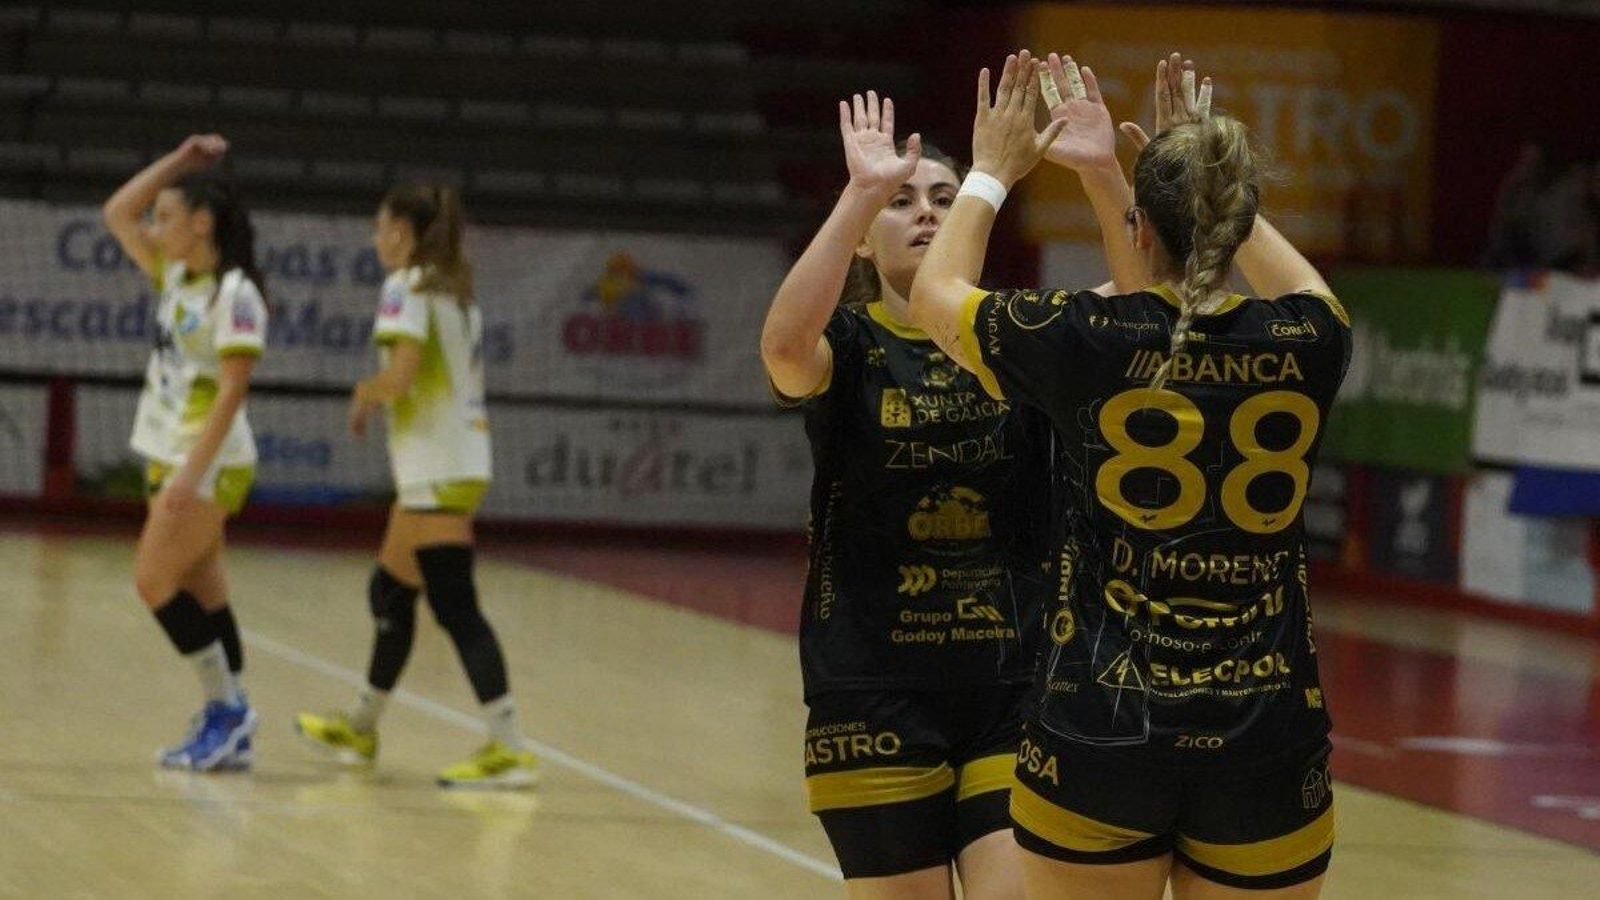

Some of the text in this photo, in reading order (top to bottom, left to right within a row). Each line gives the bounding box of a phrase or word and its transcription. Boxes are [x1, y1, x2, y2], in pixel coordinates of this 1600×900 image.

[916, 408, 941, 423] DE
[885, 434, 1015, 469] ZENDAL
[1096, 388, 1319, 533] 88
[1112, 537, 1138, 576] D.
[900, 610, 951, 624] Grupo
[891, 626, 1015, 645] Godoy Maceira
[1174, 735, 1224, 749] ZICO
